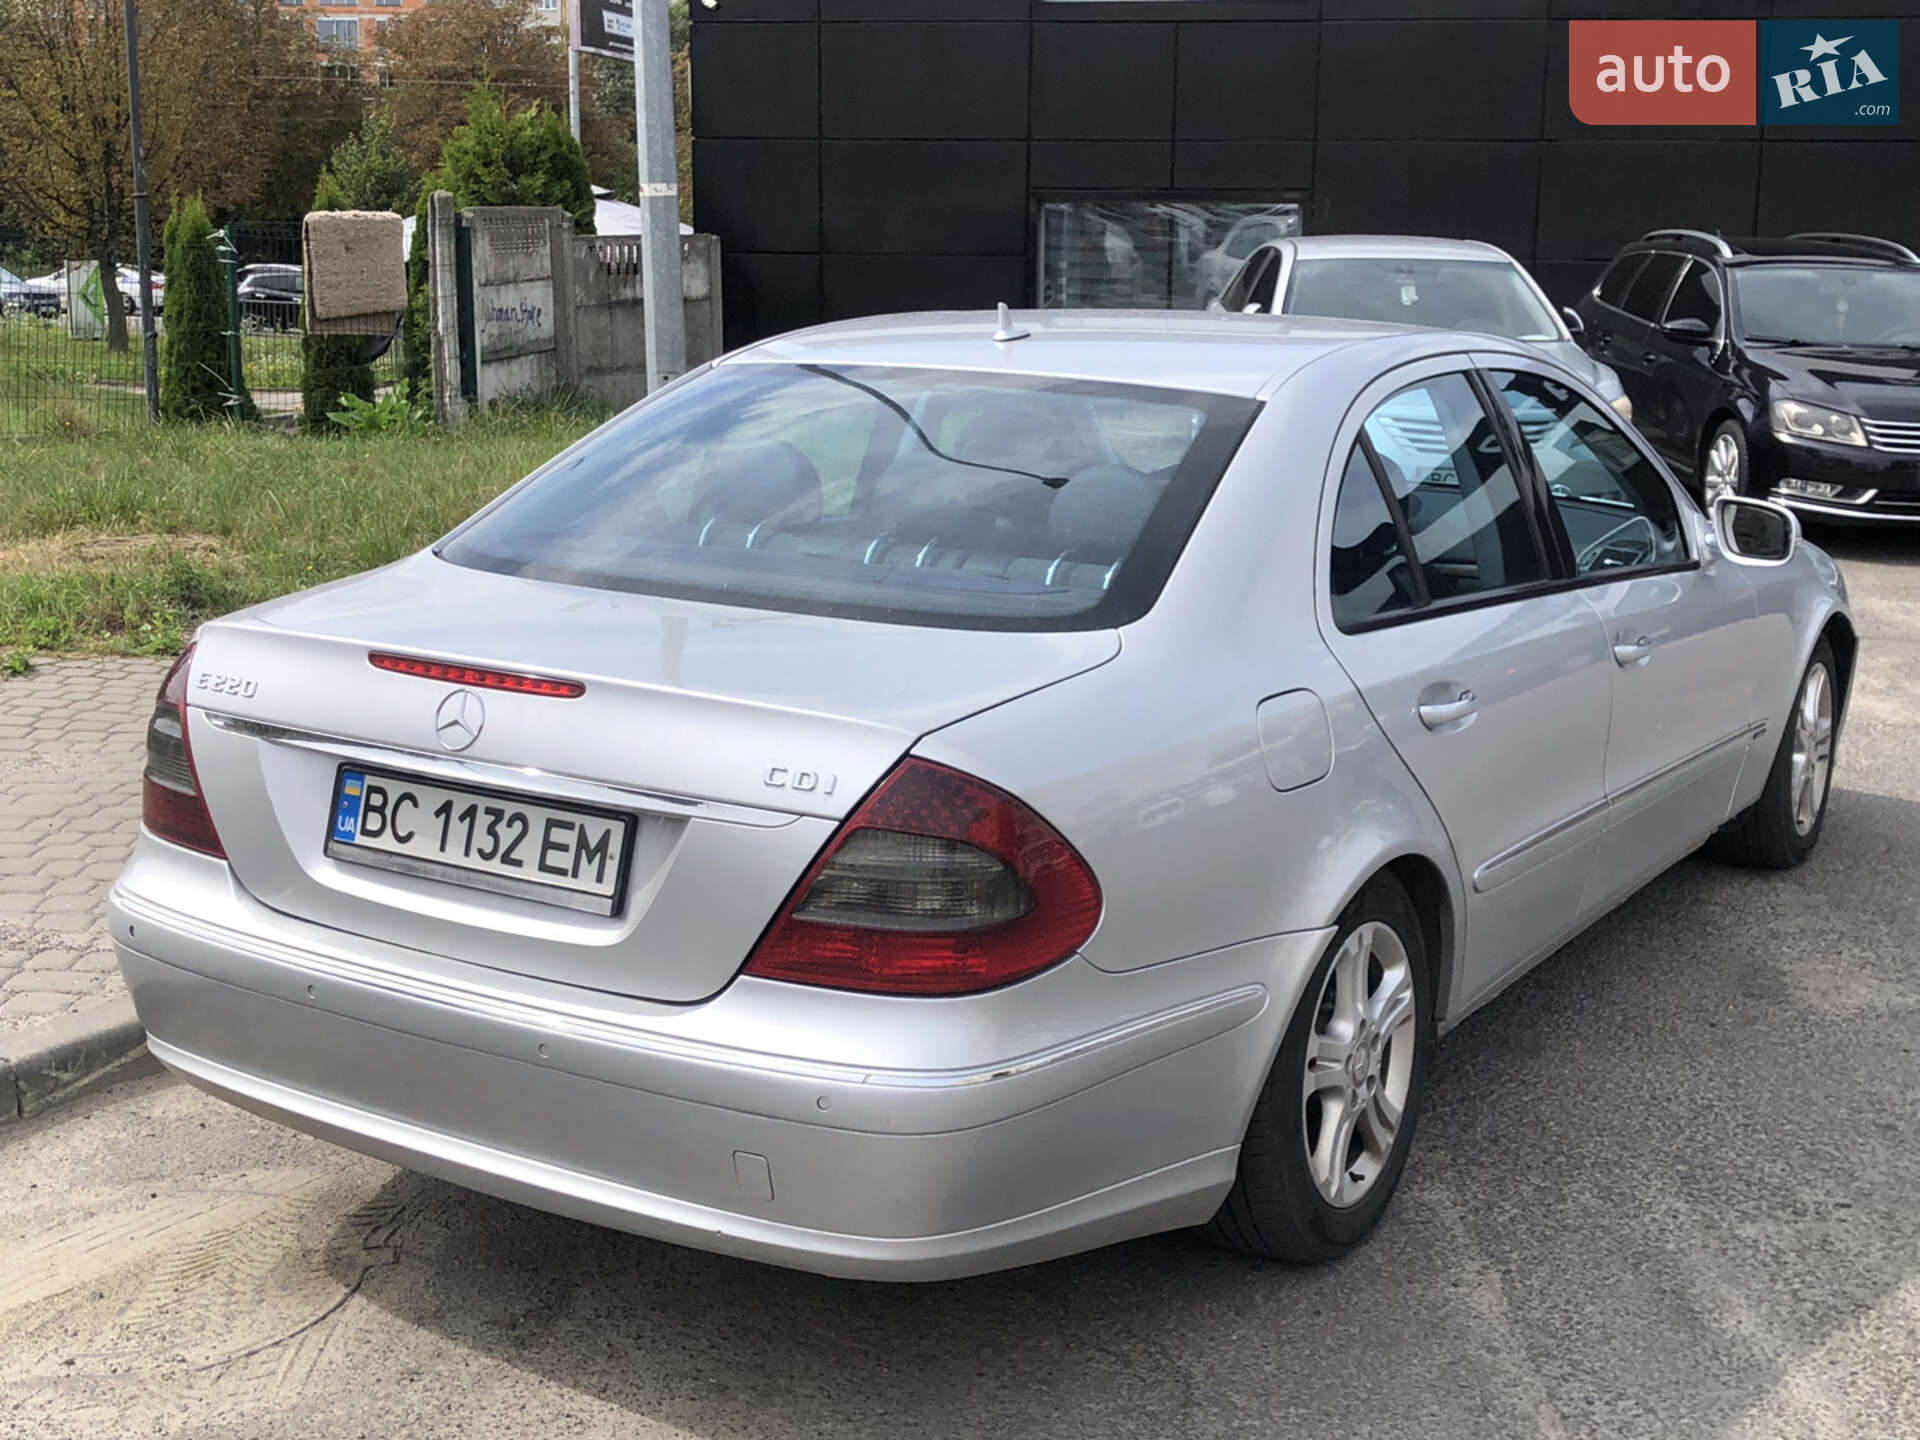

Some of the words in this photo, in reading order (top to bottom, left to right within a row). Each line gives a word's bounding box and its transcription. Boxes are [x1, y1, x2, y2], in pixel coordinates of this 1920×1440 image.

[763, 767, 838, 795] CDI
[337, 815, 355, 833] UA
[360, 785, 419, 844] BC
[434, 799, 529, 868] 1132
[538, 817, 612, 884] EM
